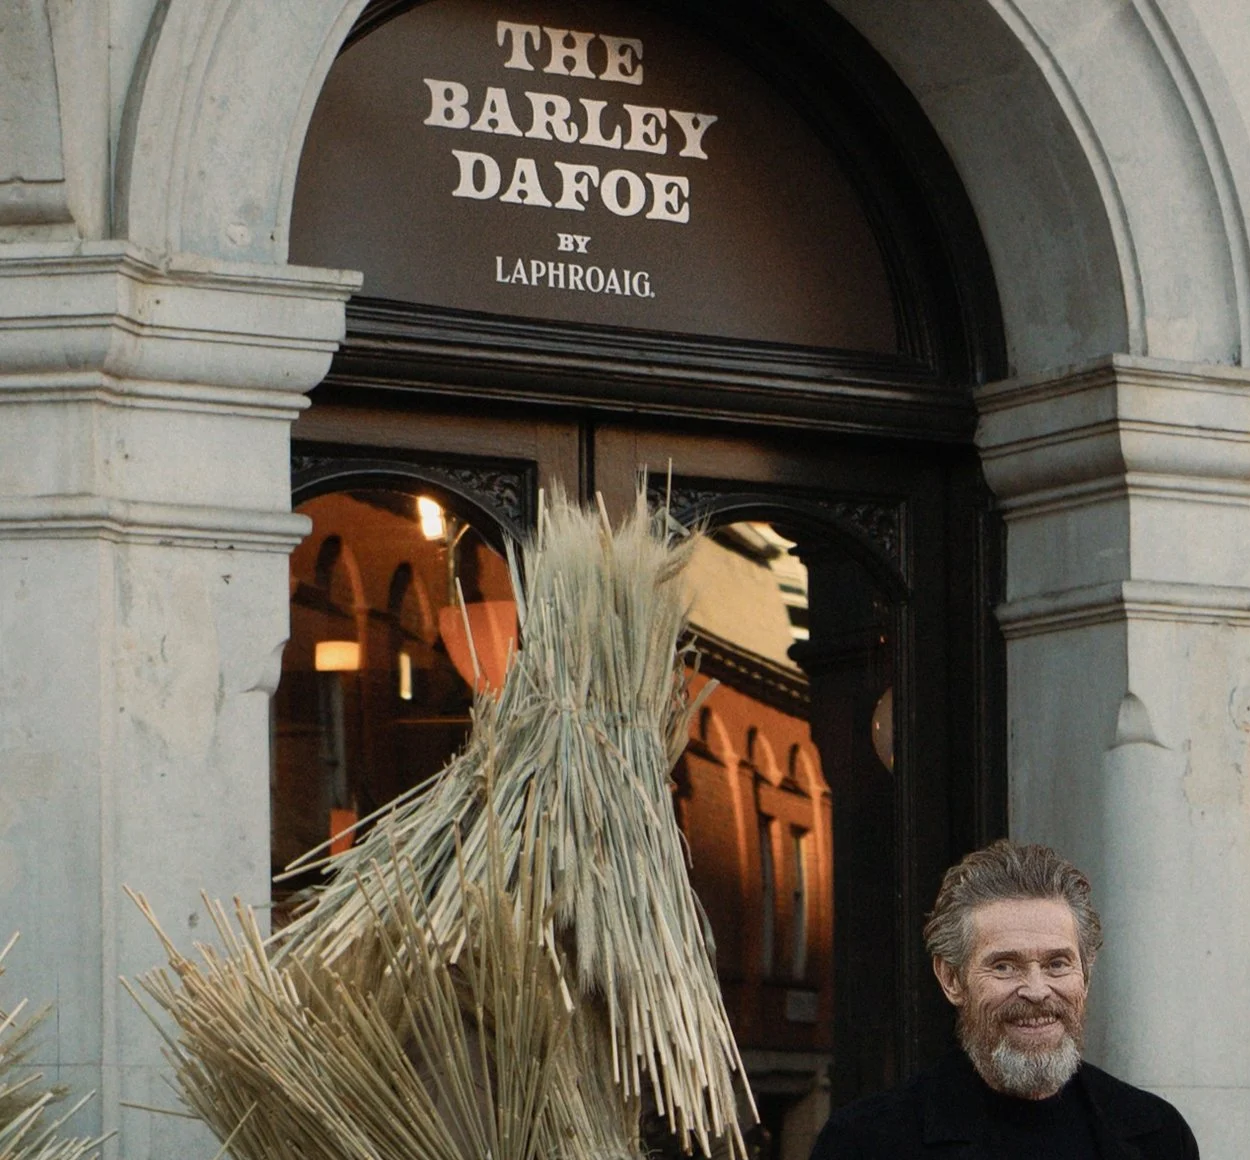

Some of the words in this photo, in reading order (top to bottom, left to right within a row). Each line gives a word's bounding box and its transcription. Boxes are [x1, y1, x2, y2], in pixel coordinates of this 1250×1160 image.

[496, 20, 644, 86] THE
[423, 78, 719, 161] BARLEY
[451, 149, 690, 224] DAFOE
[556, 233, 592, 254] BY
